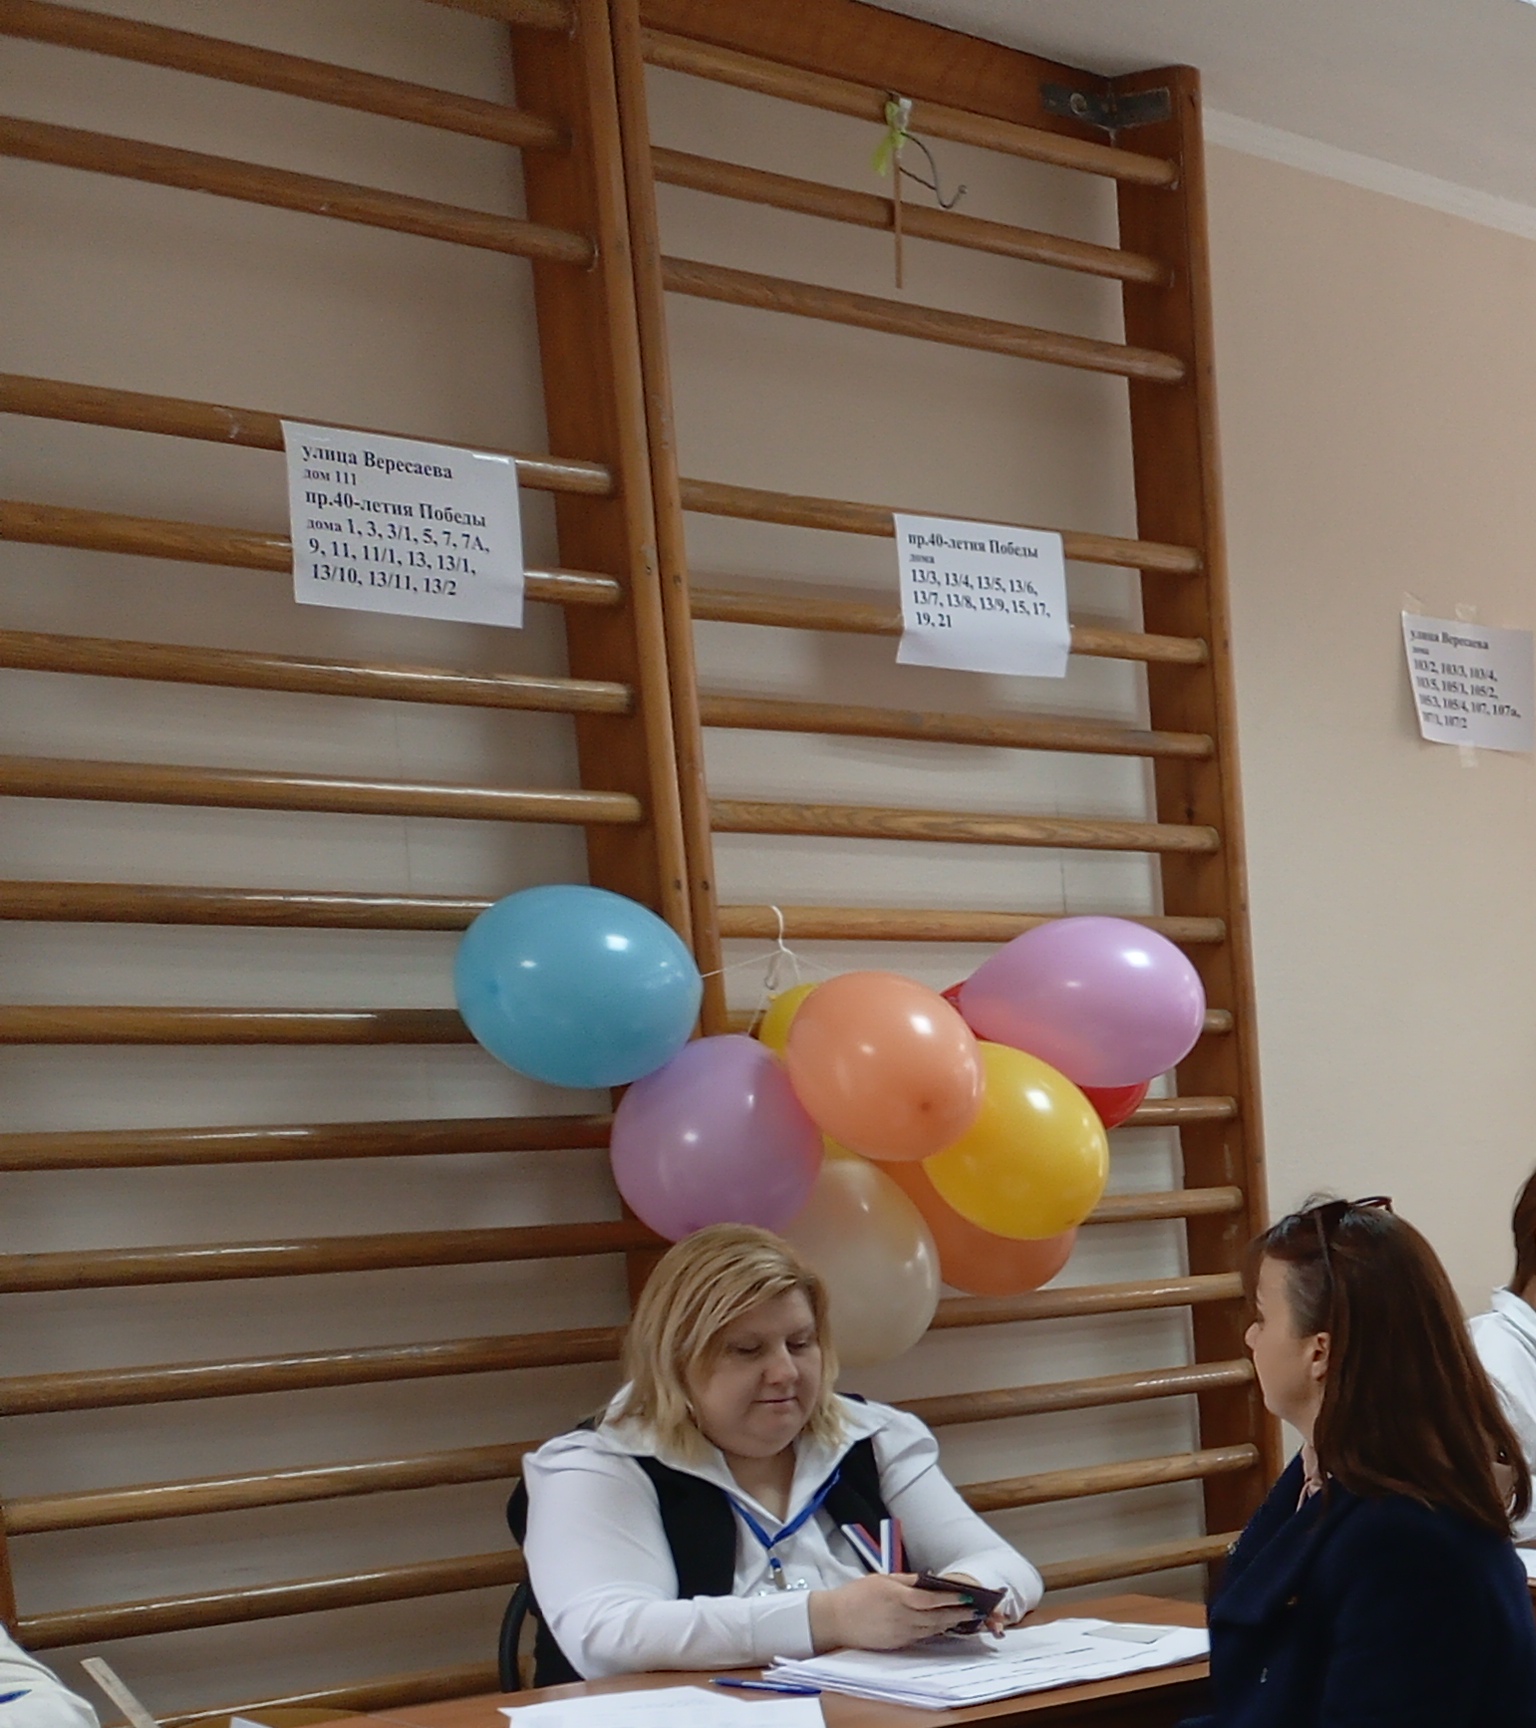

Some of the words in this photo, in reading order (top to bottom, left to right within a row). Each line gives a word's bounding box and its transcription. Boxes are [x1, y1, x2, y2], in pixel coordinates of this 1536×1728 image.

[302, 445, 357, 466] улица
[363, 450, 453, 479] Вересаева
[304, 468, 330, 481] дом
[335, 470, 356, 486] 111
[305, 491, 413, 517] пр.40-летия
[419, 503, 487, 527] Победы
[307, 519, 343, 532] дома
[347, 518, 362, 536] 1,
[366, 521, 383, 538] 3,
[387, 523, 418, 544] 3/1,
[423, 528, 438, 546] 5,
[442, 530, 457, 548] 7,
[908, 533, 986, 552] пр.40-летия
[988, 539, 1038, 558] Победы
[309, 537, 326, 556] 9,
[332, 541, 357, 560] 11,
[363, 545, 402, 566] 11/1,
[408, 551, 432, 570] 13,
[438, 555, 476, 575] 13/1,
[313, 564, 363, 585] 13/10,
[369, 571, 418, 592] 13/11,
[424, 577, 456, 596] 13/2
[912, 569, 941, 587] 13/3,
[945, 572, 974, 590] 13/4,
[977, 575, 1006, 593] 13/5,
[1009, 579, 1038, 597] 13/6,
[938, 613, 952, 628] 21
[1012, 600, 1031, 616] 15,
[1033, 602, 1051, 618] 17,
